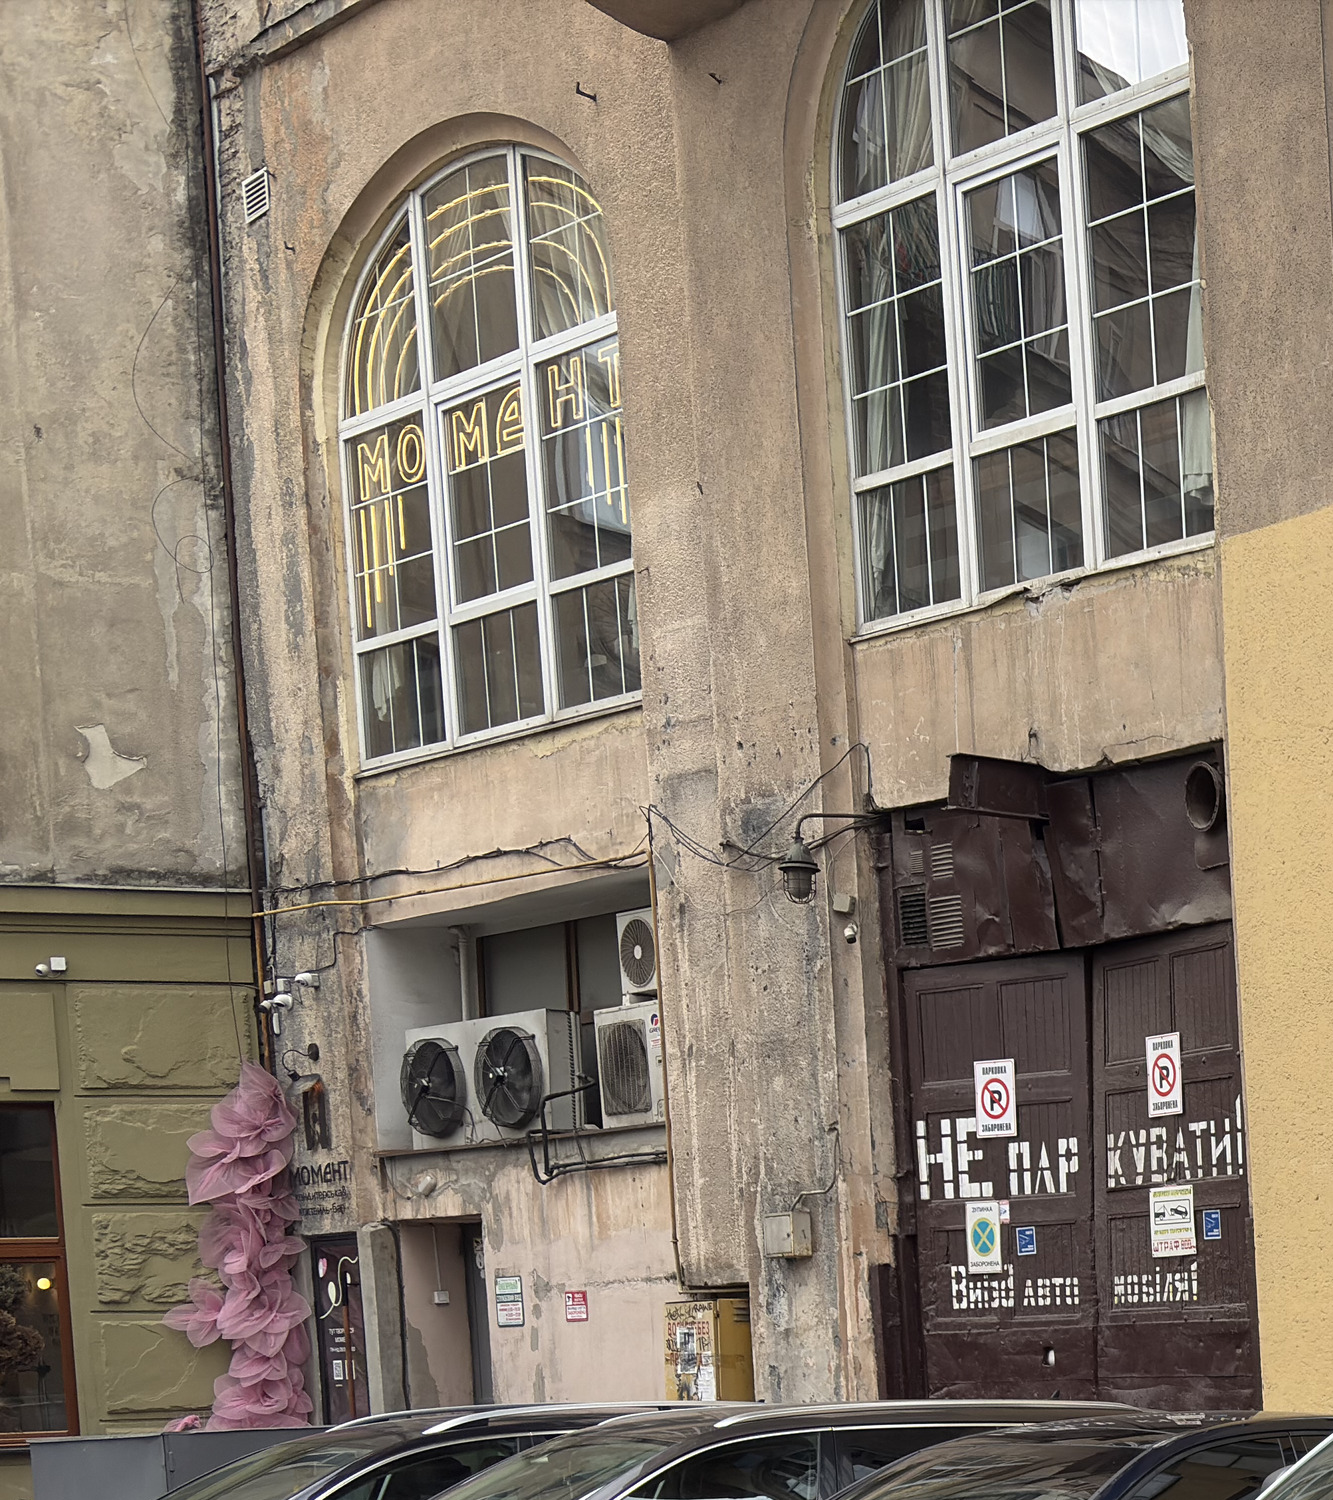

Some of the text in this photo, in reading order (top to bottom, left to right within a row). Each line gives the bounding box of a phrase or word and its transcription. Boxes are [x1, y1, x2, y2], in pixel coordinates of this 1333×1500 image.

[1153, 1039, 1173, 1051] ПАРКОВКА
[982, 1065, 1007, 1075] ПАРКОВКА
[1153, 1100, 1178, 1111] ЗАБОРОНЕНА
[982, 1122, 1012, 1132] ЗАБОРОНЕНА
[916, 1117, 993, 1200] НЕ
[1008, 1137, 1079, 1196] ПАР
[1153, 1240, 1179, 1252] ШТРАФ
